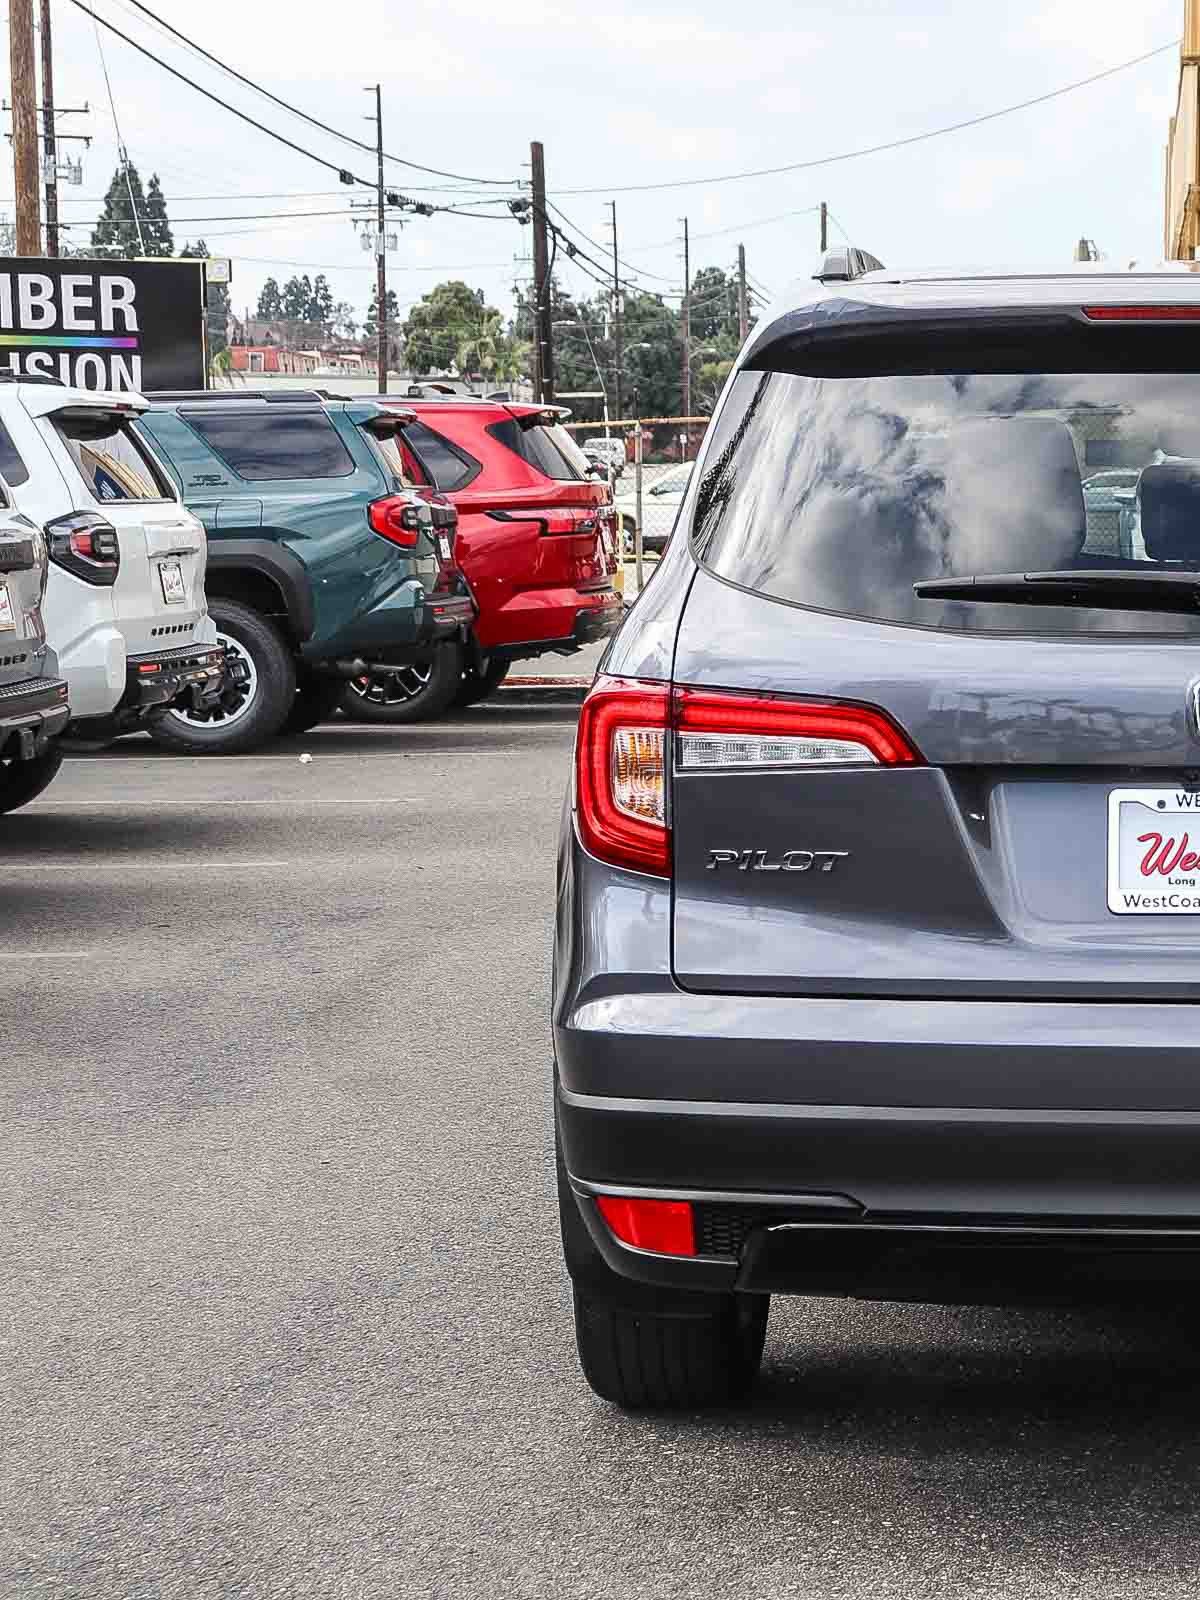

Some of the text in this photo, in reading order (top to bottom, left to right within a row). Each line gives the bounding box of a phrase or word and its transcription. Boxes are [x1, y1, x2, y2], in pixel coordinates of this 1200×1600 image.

[0, 273, 140, 332] BER
[705, 849, 849, 871] PILOT
[1168, 877, 1196, 887] Long
